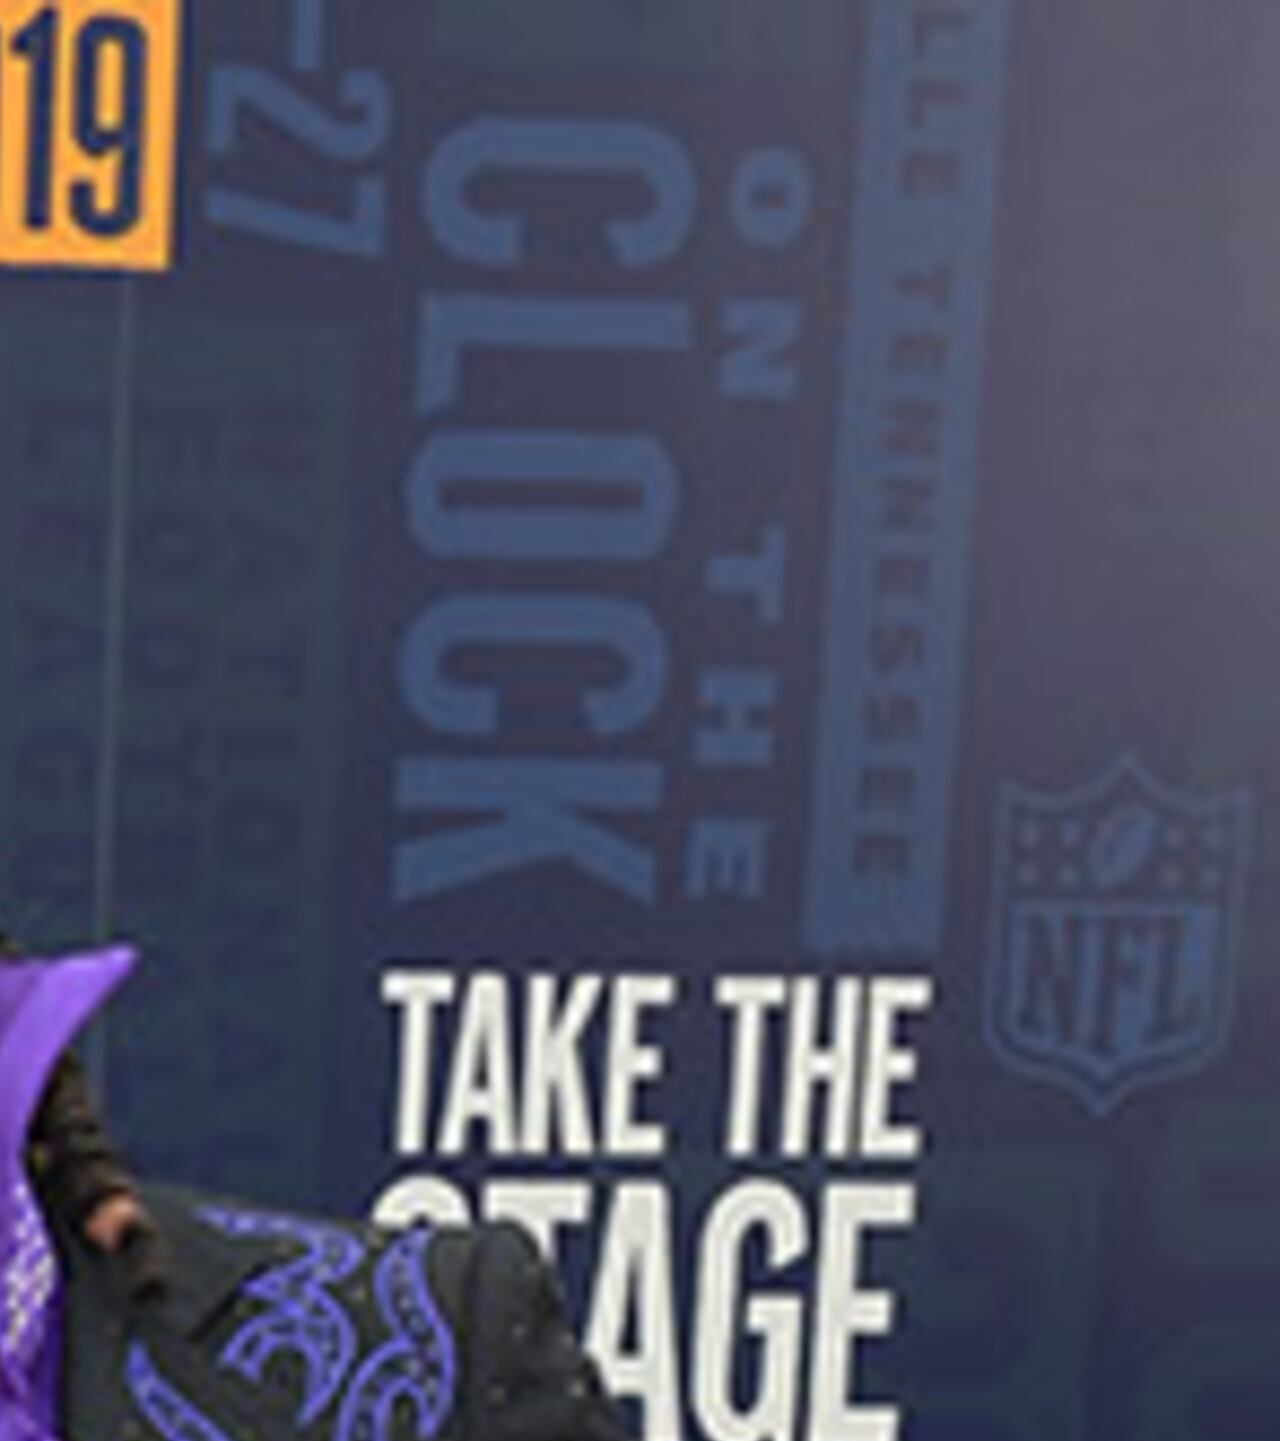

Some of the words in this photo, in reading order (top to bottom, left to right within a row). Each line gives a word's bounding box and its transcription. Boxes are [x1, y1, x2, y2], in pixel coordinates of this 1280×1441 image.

[717, 147, 811, 400] ON
[388, 115, 696, 906] CLOCK
[852, 263, 954, 880] TENNESSEE
[689, 527, 783, 898] THE
[381, 972, 676, 1155] TAKE
[716, 975, 932, 1156] THE
[1017, 906, 1212, 1042] NFL
